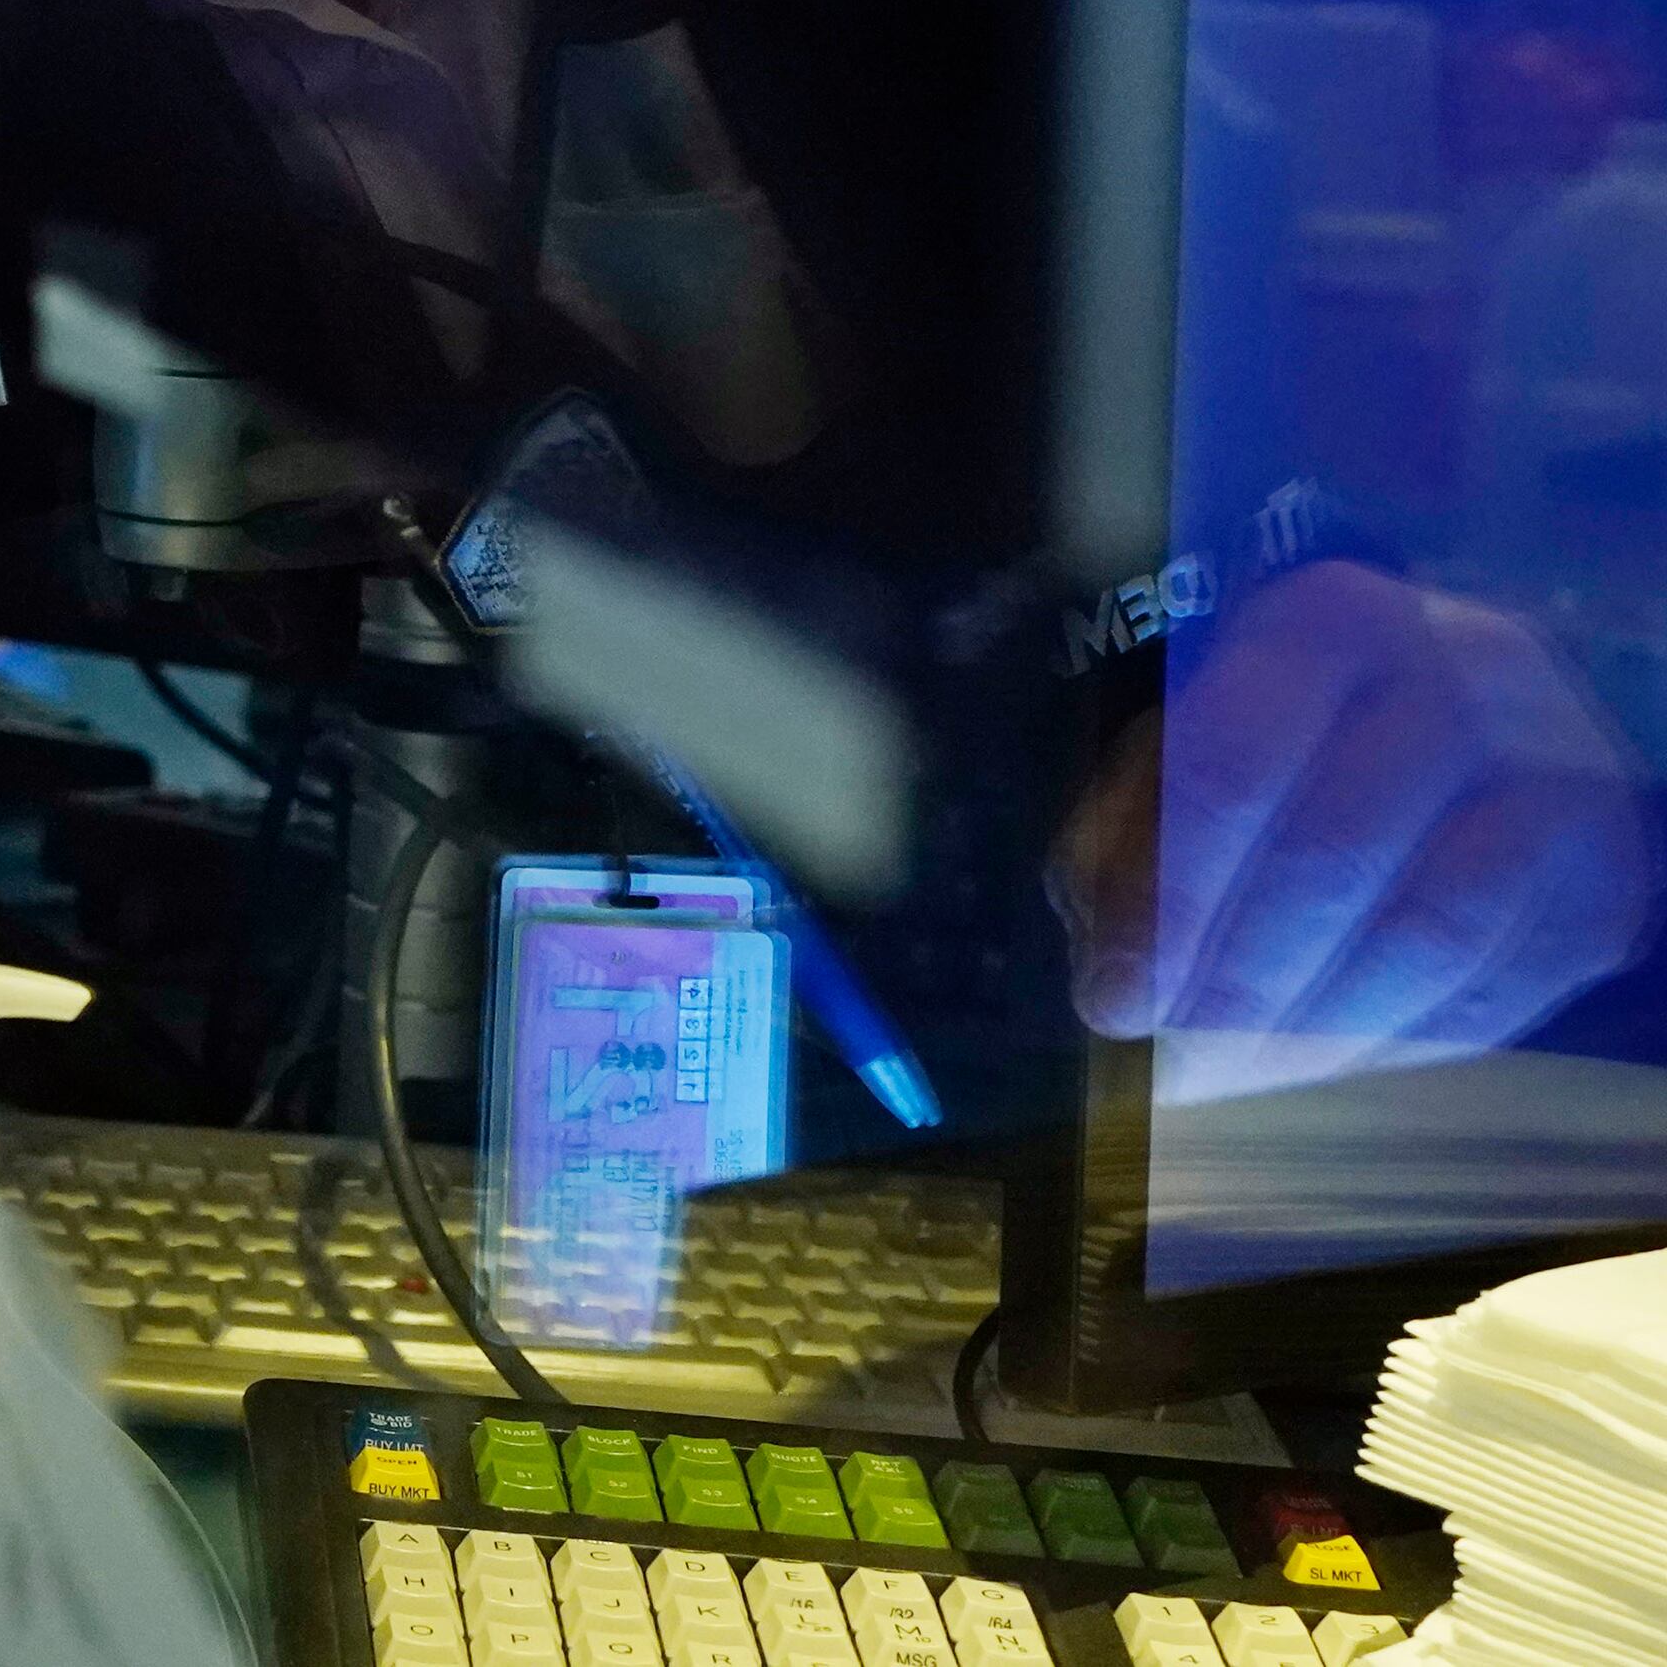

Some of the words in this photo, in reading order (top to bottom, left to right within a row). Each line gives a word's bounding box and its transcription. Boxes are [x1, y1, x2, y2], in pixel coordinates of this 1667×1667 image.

[495, 1426, 538, 1437] TRADE
[587, 1436, 631, 1446] BLOCK
[683, 1444, 719, 1455] FIND
[770, 1452, 818, 1463] QUOTE
[368, 1482, 396, 1496] BUY
[401, 1486, 430, 1500] MKT
[398, 1533, 419, 1544] A
[493, 1541, 512, 1551] B
[589, 1551, 612, 1562] C
[685, 1560, 706, 1573] D
[785, 1570, 805, 1582] E
[1310, 1567, 1328, 1580] SL
[1332, 1569, 1363, 1583] MKT
[403, 1575, 426, 1588] H
[883, 1579, 901, 1590] F
[981, 1589, 1004, 1601] G
[697, 1605, 720, 1618] K
[1162, 1606, 1172, 1616] 1
[798, 1613, 819, 1625] L
[1259, 1614, 1277, 1625] 2
[410, 1623, 434, 1635] O
[895, 1624, 922, 1636] M
[1360, 1623, 1380, 1635] 3
[511, 1634, 529, 1644] P
[995, 1634, 1021, 1646] N
[608, 1642, 633, 1655] Q
[711, 1653, 731, 1665] R
[896, 1652, 937, 1667] MSG
